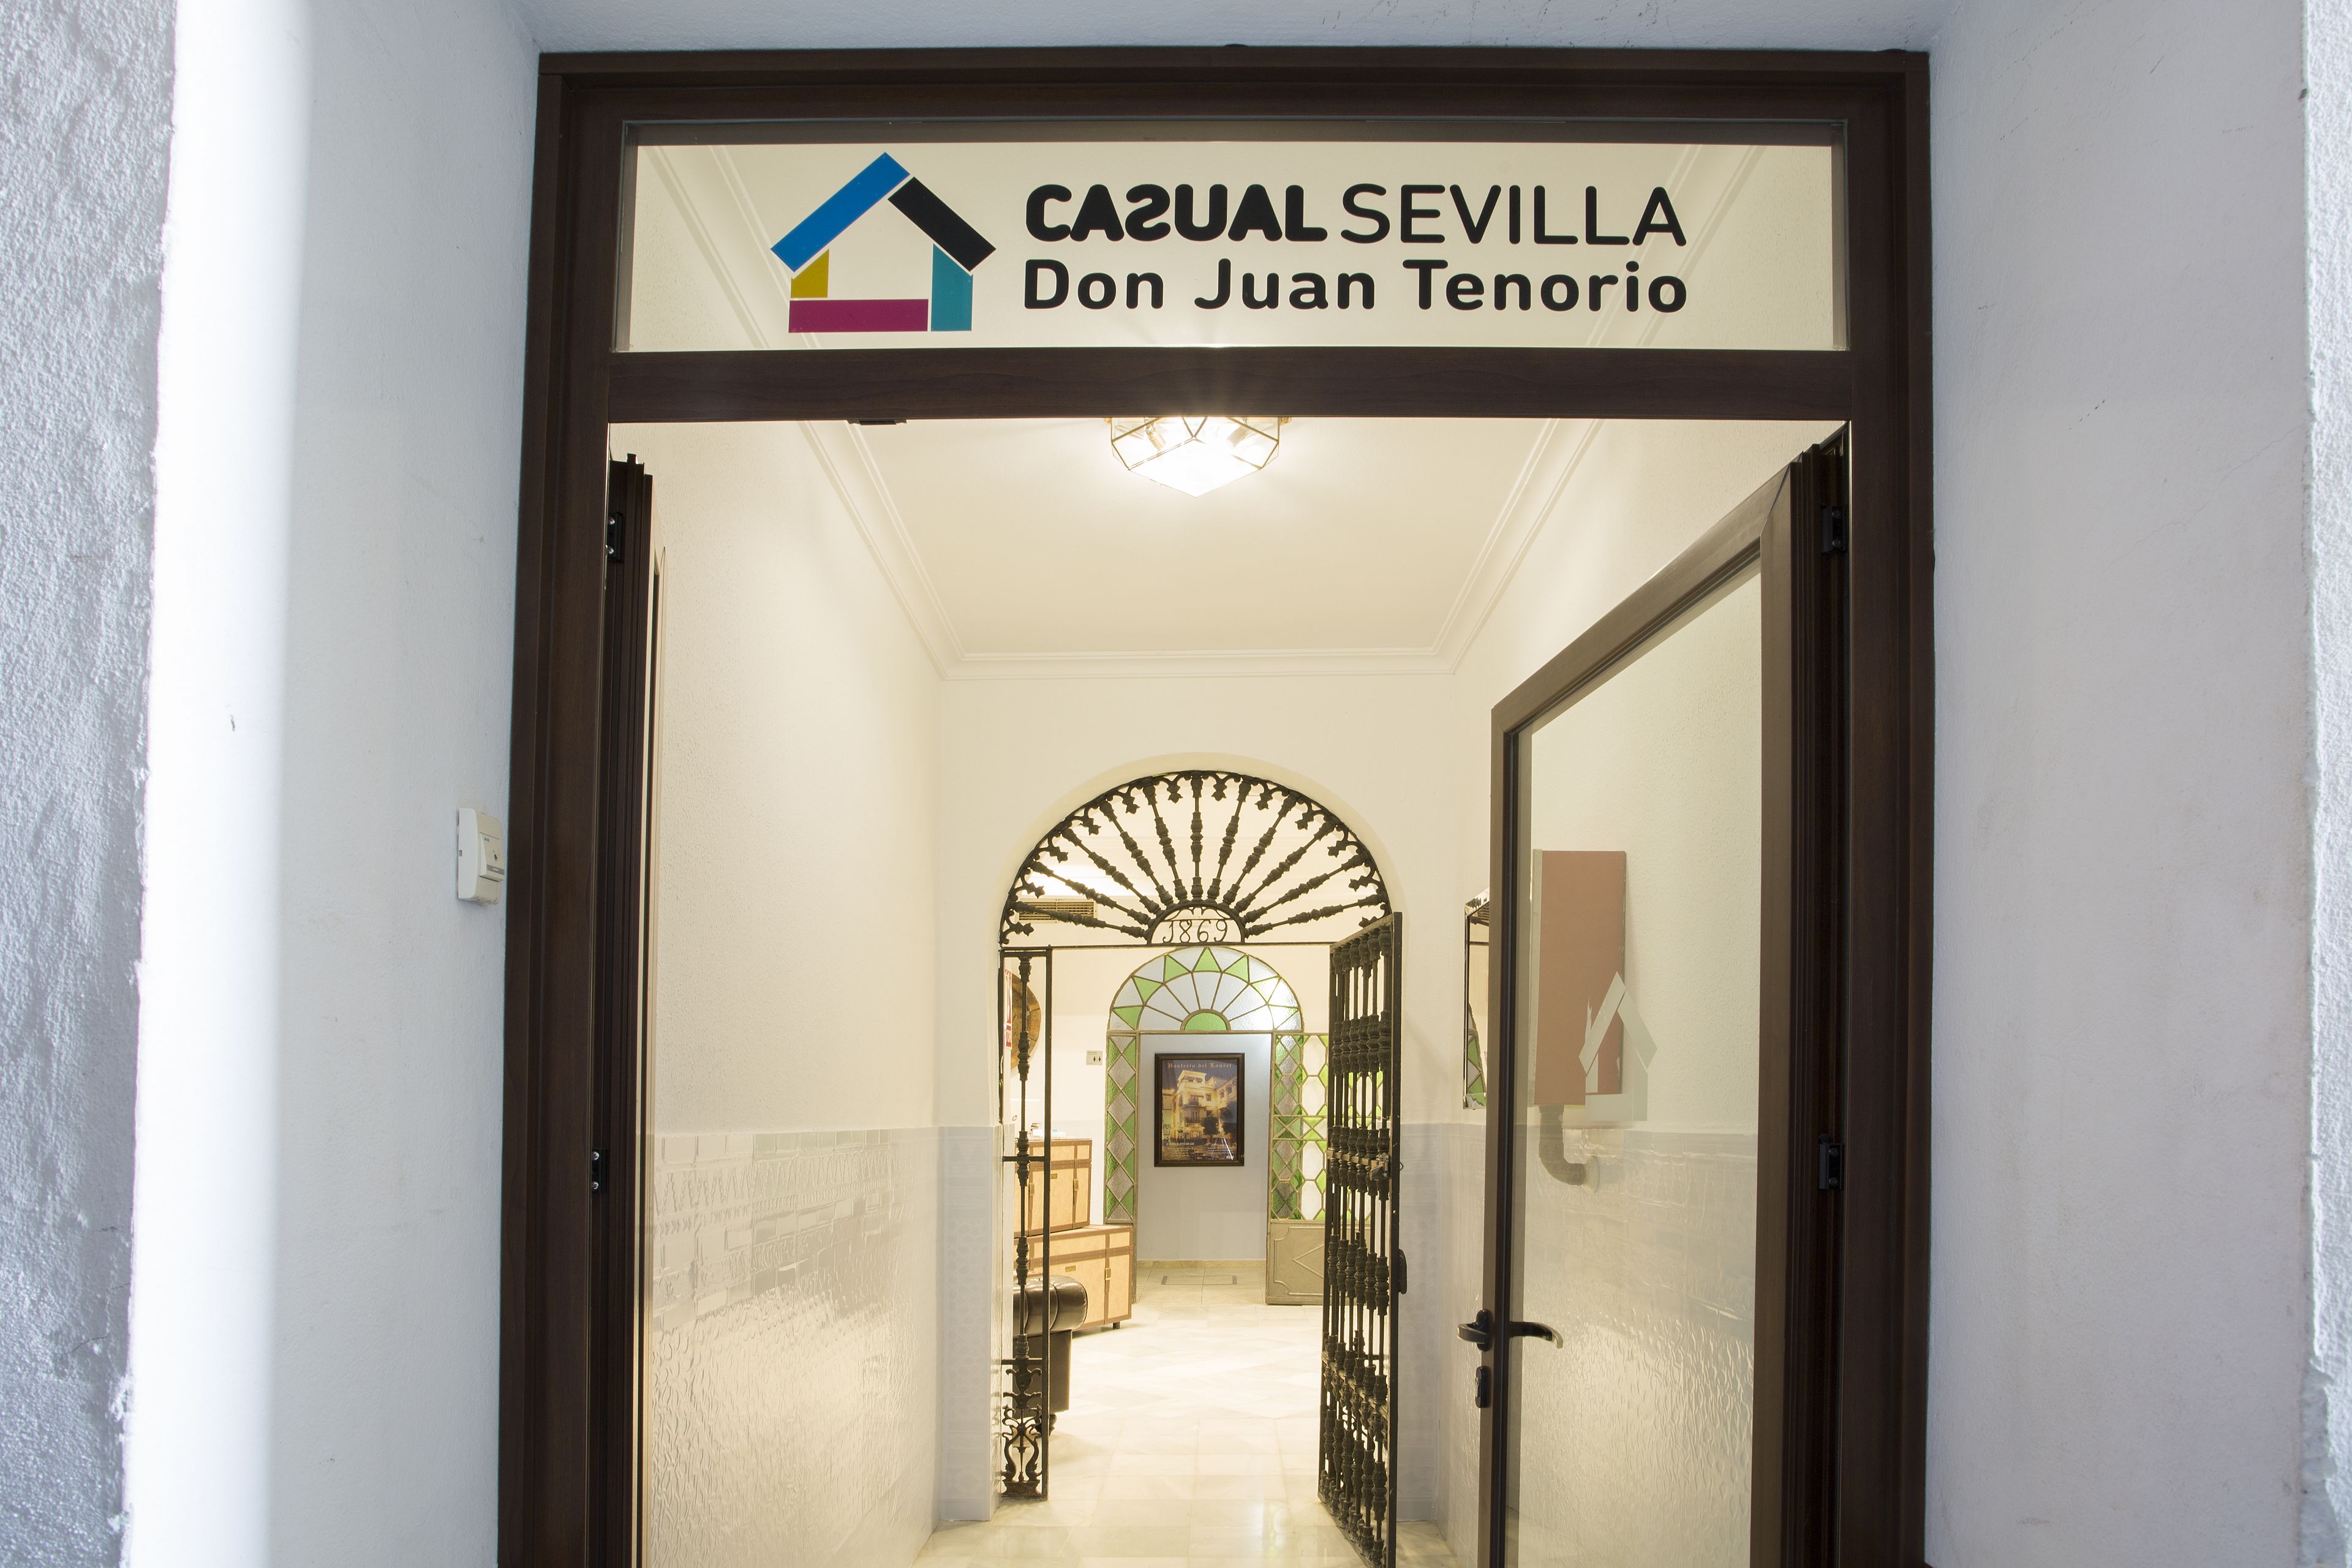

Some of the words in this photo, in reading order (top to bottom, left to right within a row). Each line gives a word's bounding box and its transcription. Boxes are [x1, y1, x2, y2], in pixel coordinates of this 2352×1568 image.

[1025, 183, 1328, 243] CASUAL
[1340, 183, 1687, 247] SEVILLA
[1024, 258, 1164, 310] Don
[1194, 258, 1376, 310] Juan
[1402, 259, 1687, 313] Tenorio
[1162, 919, 1227, 943] 1869
